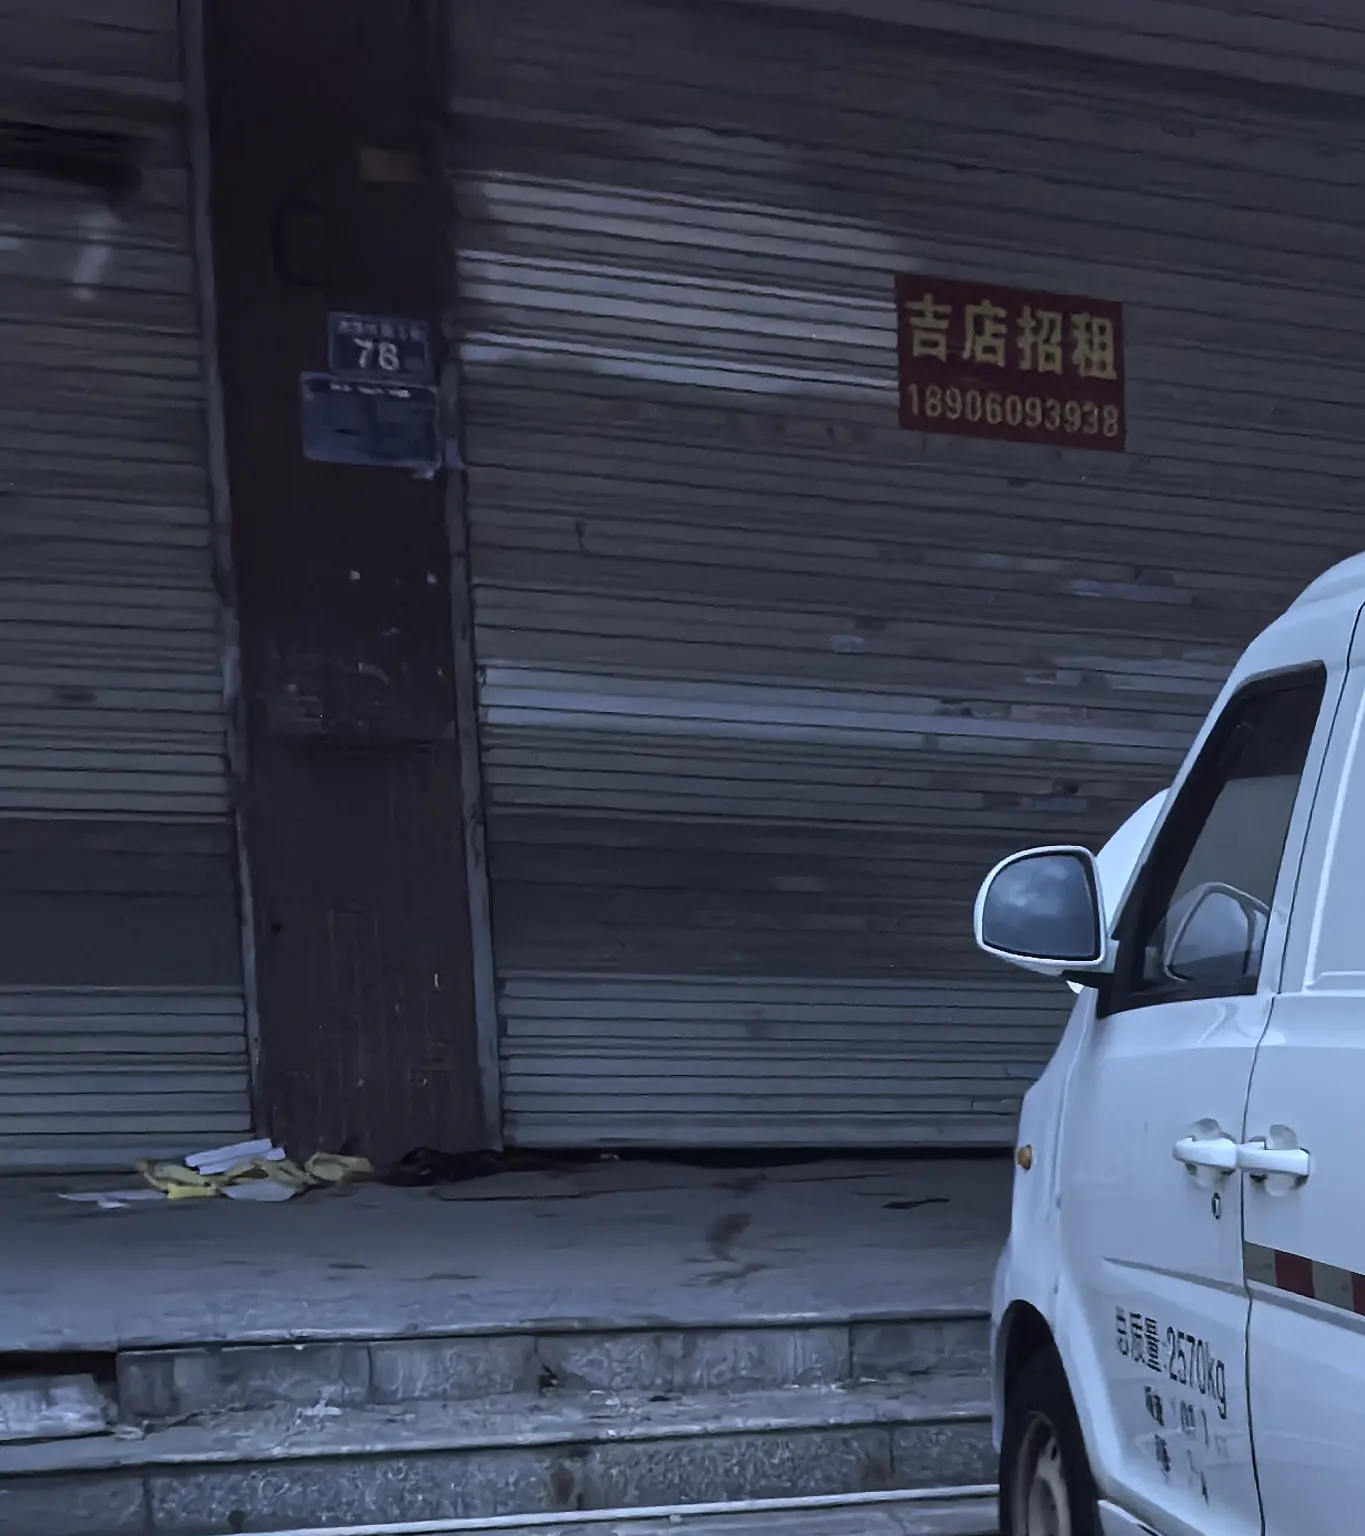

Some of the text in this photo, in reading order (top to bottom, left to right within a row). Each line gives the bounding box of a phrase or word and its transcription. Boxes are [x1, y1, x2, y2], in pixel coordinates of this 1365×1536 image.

[904, 292, 1117, 380] 吉店招租
[907, 383, 1120, 437] 18906093938
